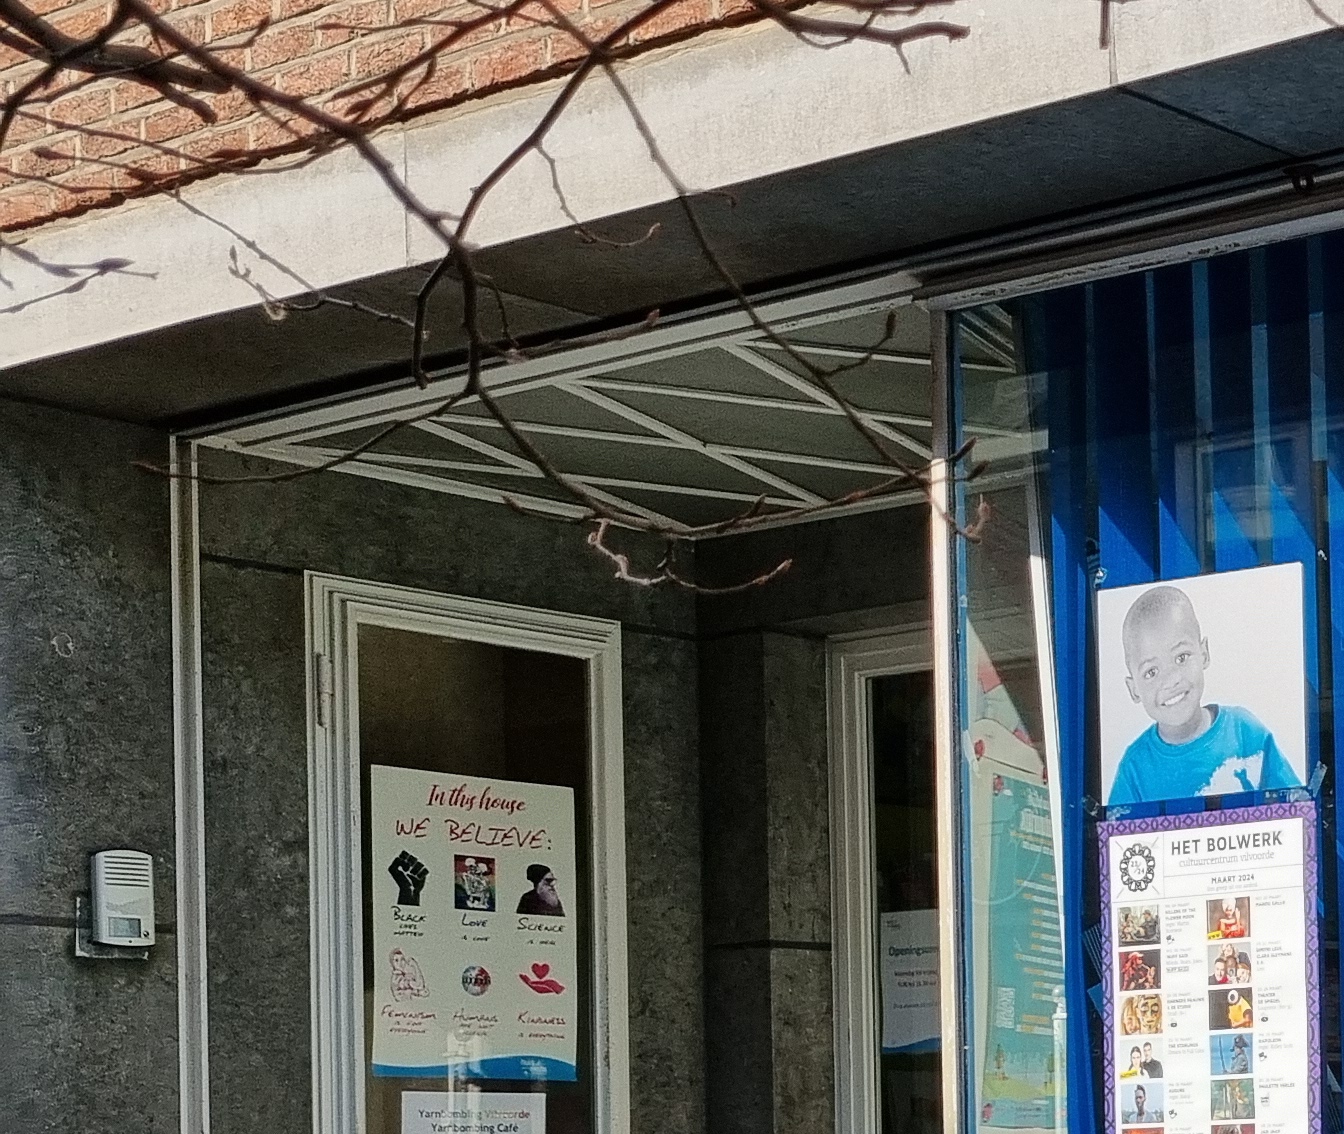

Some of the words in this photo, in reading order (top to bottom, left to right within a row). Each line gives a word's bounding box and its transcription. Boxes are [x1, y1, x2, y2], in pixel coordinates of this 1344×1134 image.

[426, 784, 446, 806] In
[449, 783, 476, 812] this
[479, 786, 527, 815] house
[396, 818, 431, 838] WE
[444, 819, 553, 850] BELIEVE:
[1171, 838, 1201, 856] HET
[1206, 830, 1283, 853] BOLWERK
[1178, 853, 1239, 868] cultuurcentrum
[1240, 849, 1275, 862] vilvoorde
[1211, 874, 1236, 884] MAART
[1238, 873, 1255, 882] 2024
[497, 1122, 520, 1133] Café
